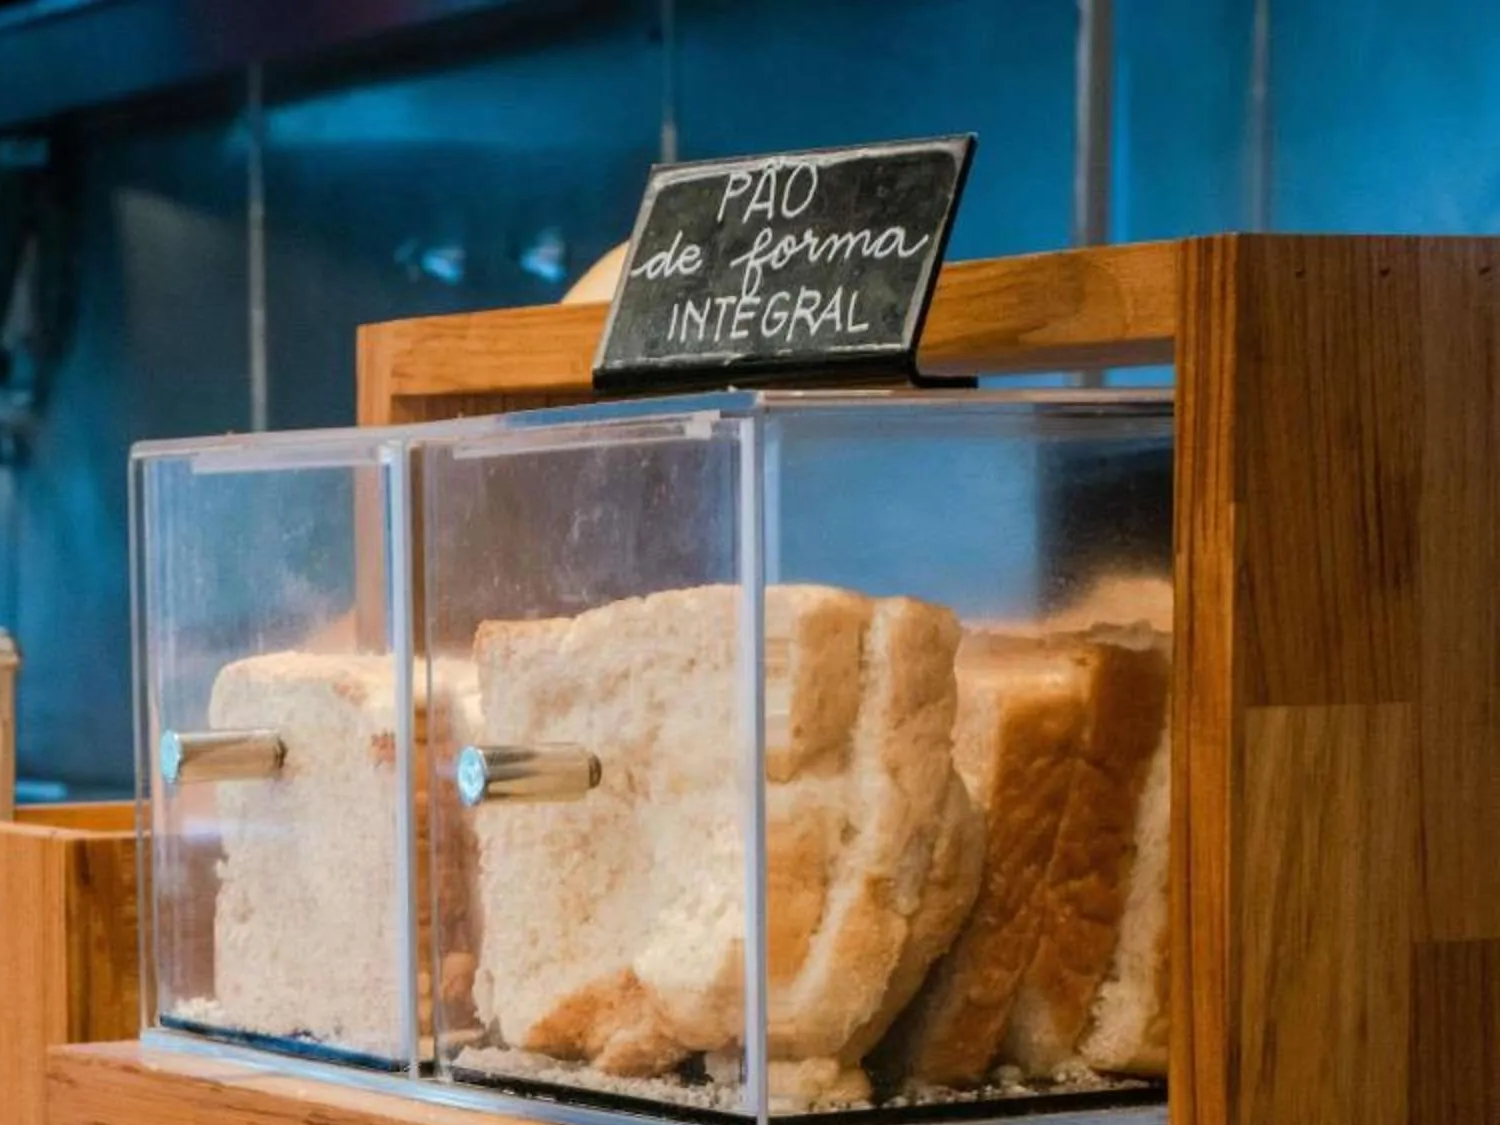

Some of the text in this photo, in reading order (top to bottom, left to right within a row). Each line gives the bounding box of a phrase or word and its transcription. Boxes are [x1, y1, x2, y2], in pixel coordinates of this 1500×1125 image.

[632, 225, 930, 297] de forma
[667, 285, 870, 343] INTEGRAL
